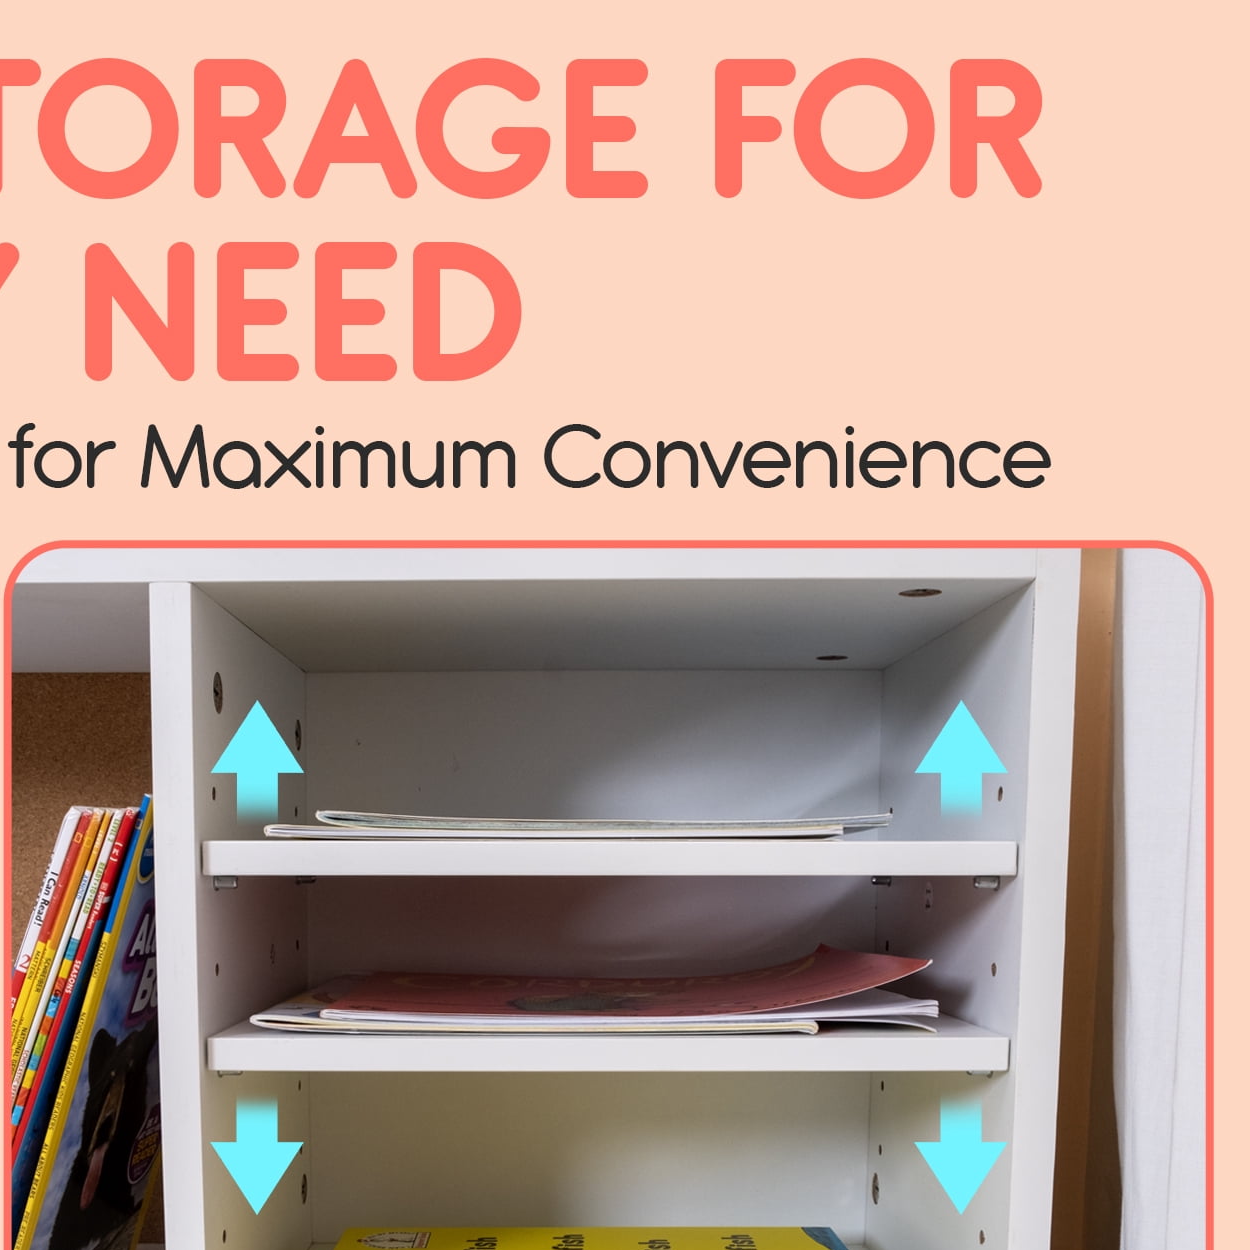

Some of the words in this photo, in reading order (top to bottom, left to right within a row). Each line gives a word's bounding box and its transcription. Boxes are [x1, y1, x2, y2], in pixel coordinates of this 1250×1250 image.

[44, 877, 57, 896] Can
[93, 891, 106, 911] SUPER
[33, 900, 50, 927] Read!
[19, 953, 31, 970] 2
[27, 950, 41, 980] MATTERN
[34, 957, 52, 993] SCHREIBER
[65, 960, 82, 995] SEASONS
[551, 1233, 585, 1250] fish
